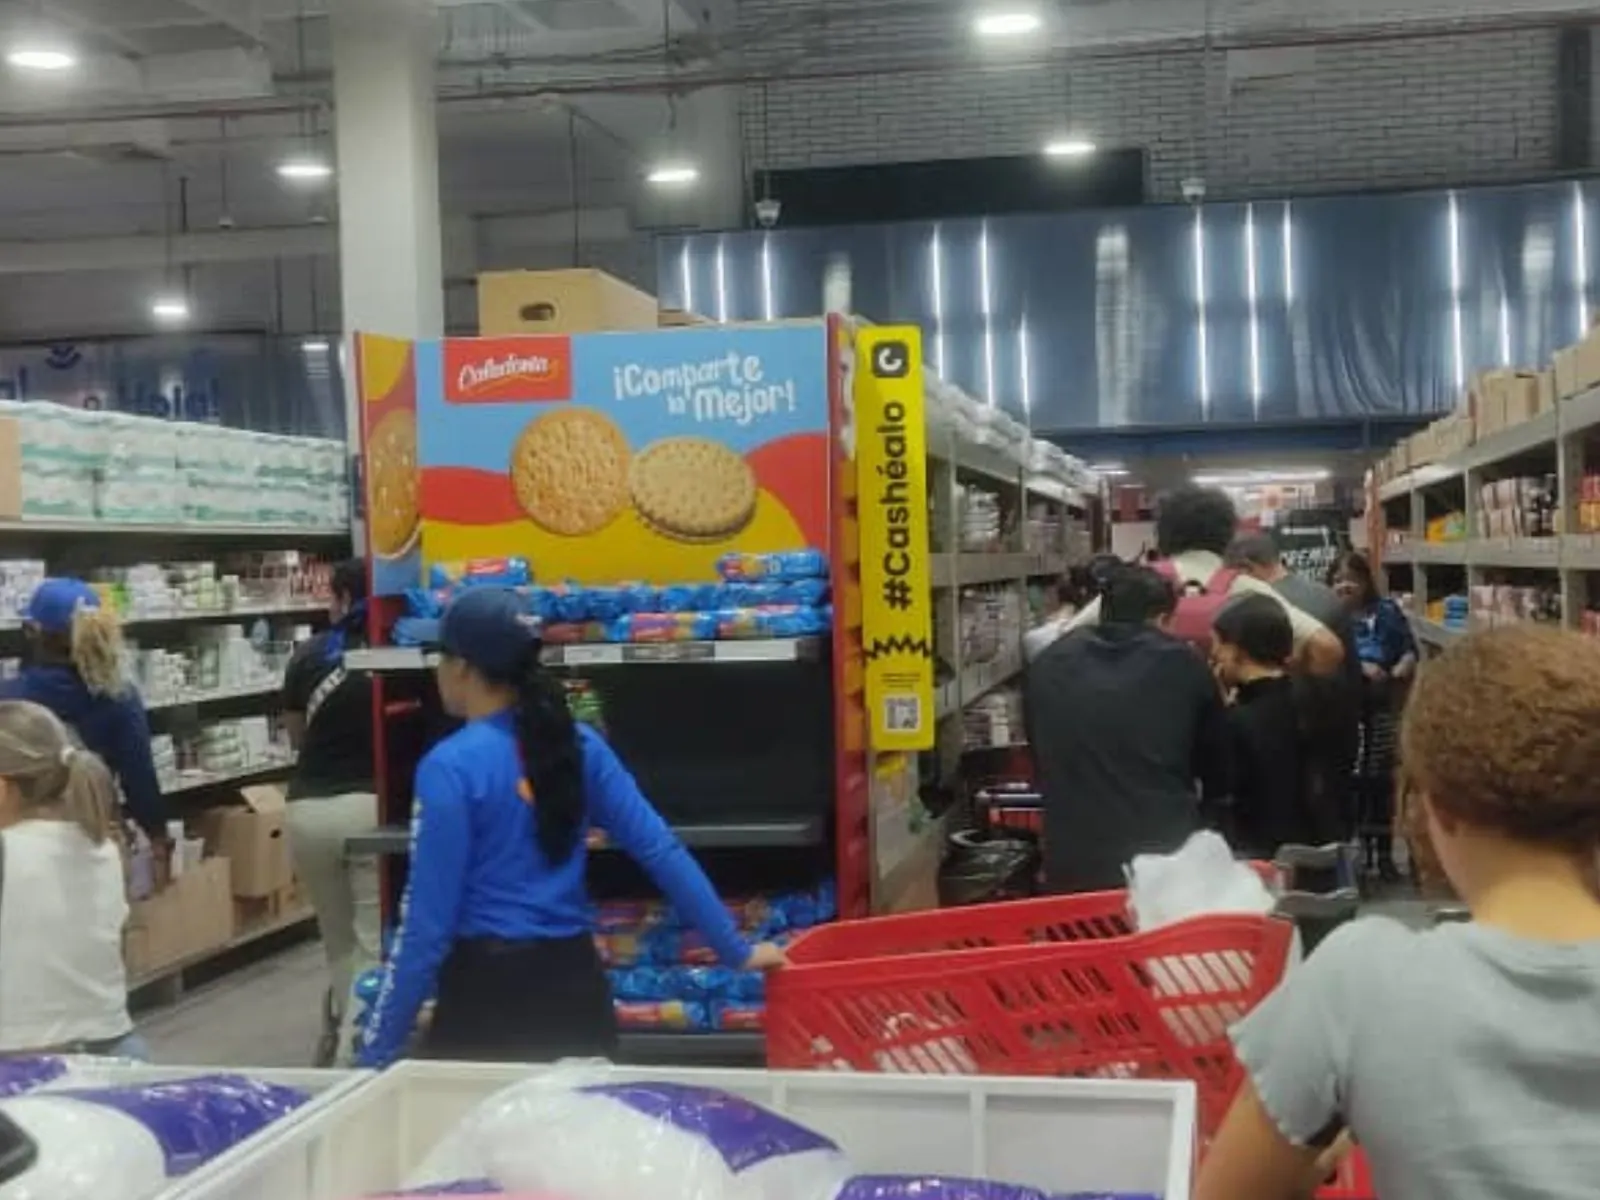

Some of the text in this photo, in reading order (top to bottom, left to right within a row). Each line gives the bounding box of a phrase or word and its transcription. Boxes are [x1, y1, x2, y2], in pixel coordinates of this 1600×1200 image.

[613, 352, 764, 400] ¡Comparte
[694, 379, 796, 425] Mejor!
[876, 402, 912, 611] #Cashéalo
